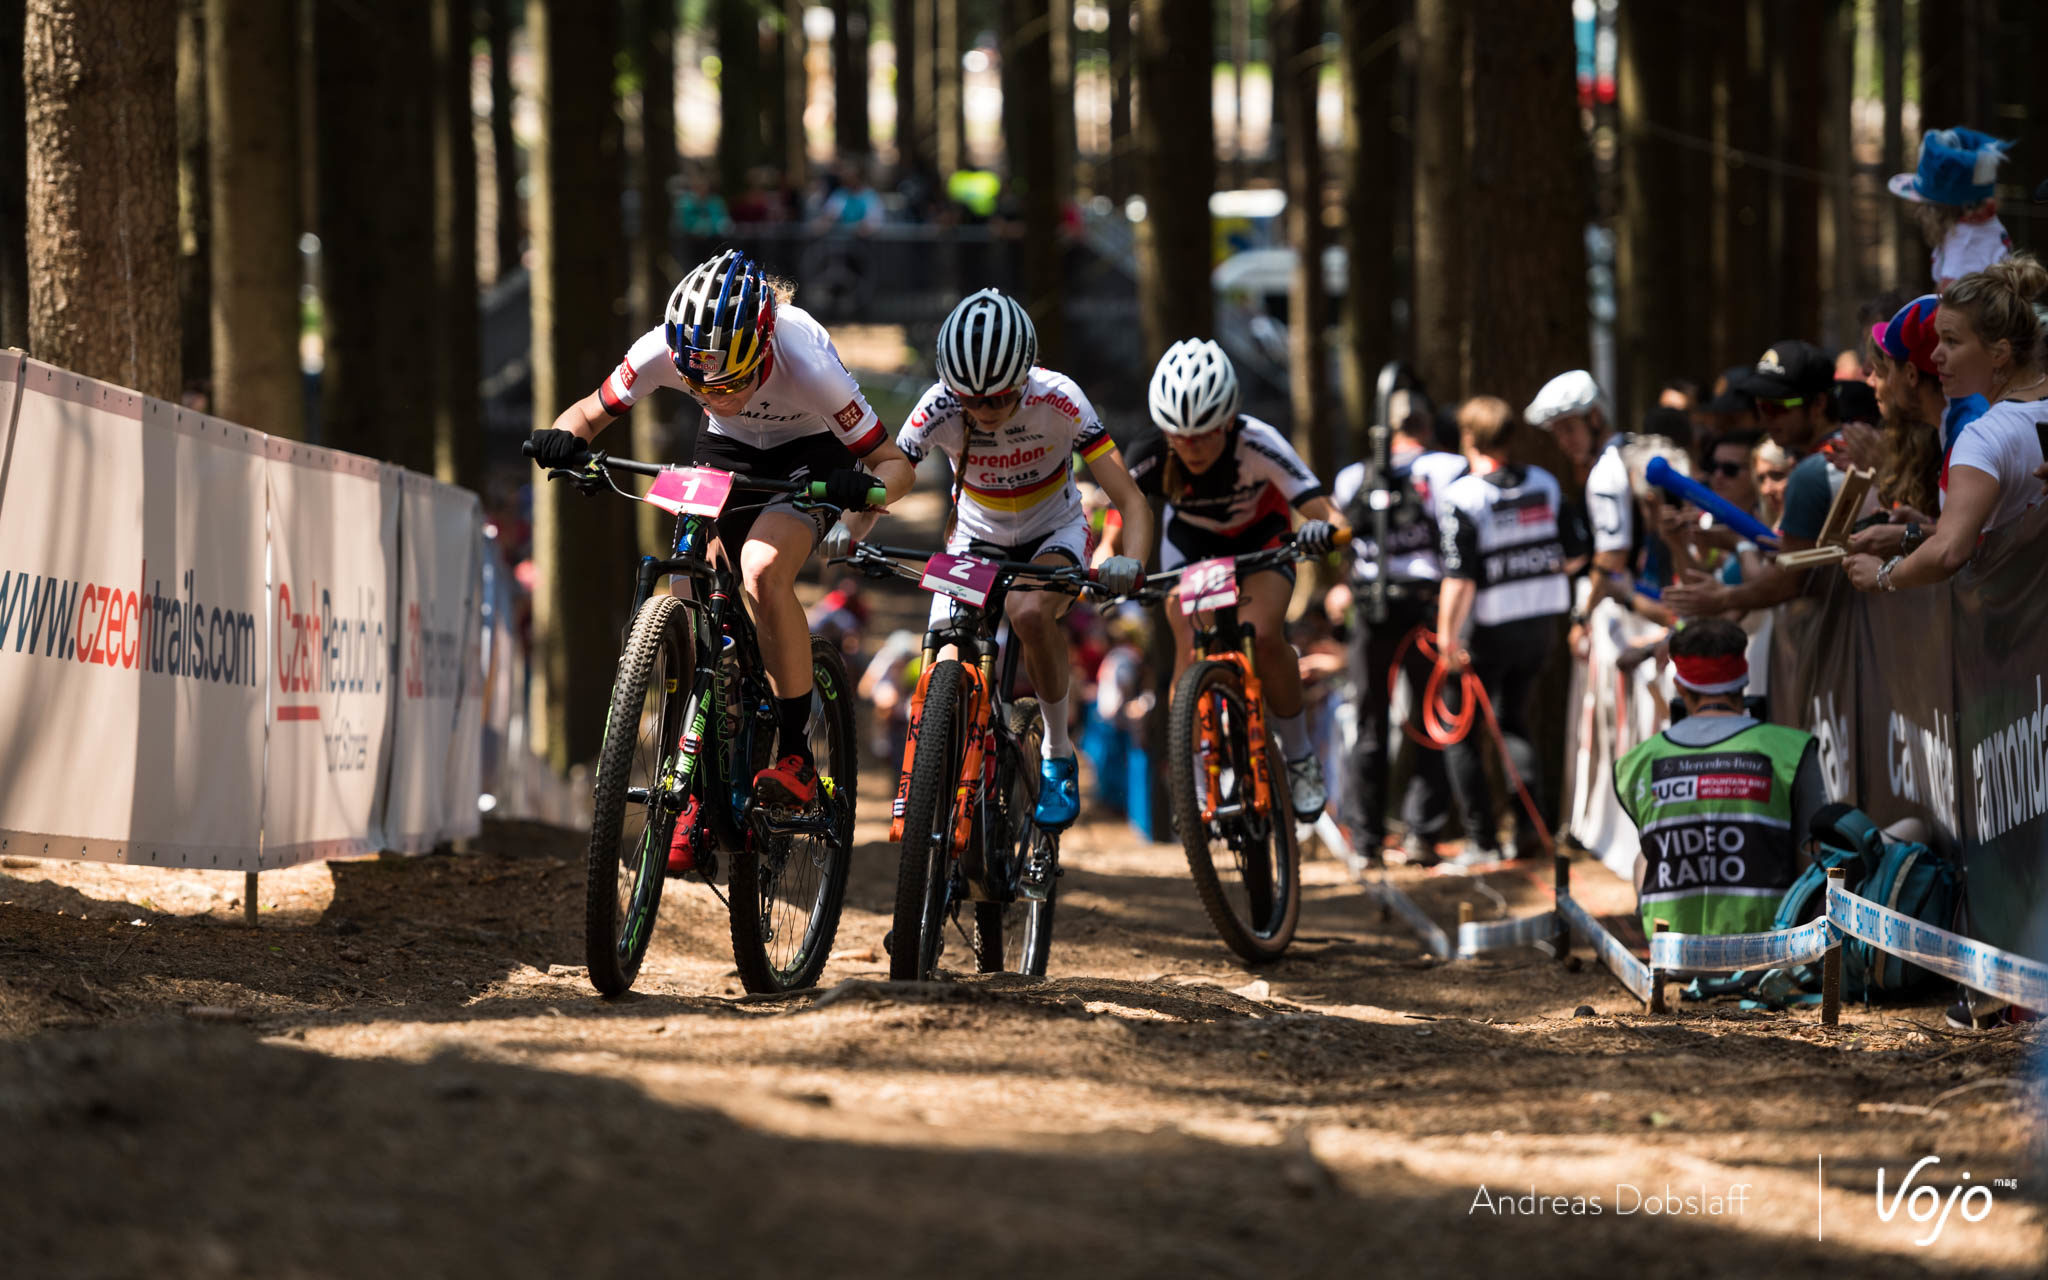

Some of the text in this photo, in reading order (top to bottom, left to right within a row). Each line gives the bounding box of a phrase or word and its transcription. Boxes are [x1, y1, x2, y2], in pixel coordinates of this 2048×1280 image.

[957, 446, 1045, 469] orendon
[979, 469, 1039, 485] Circus
[681, 477, 702, 501] 1
[948, 559, 976, 580] 2
[1658, 780, 1694, 800] UCI
[1653, 825, 1745, 859] VIDEO
